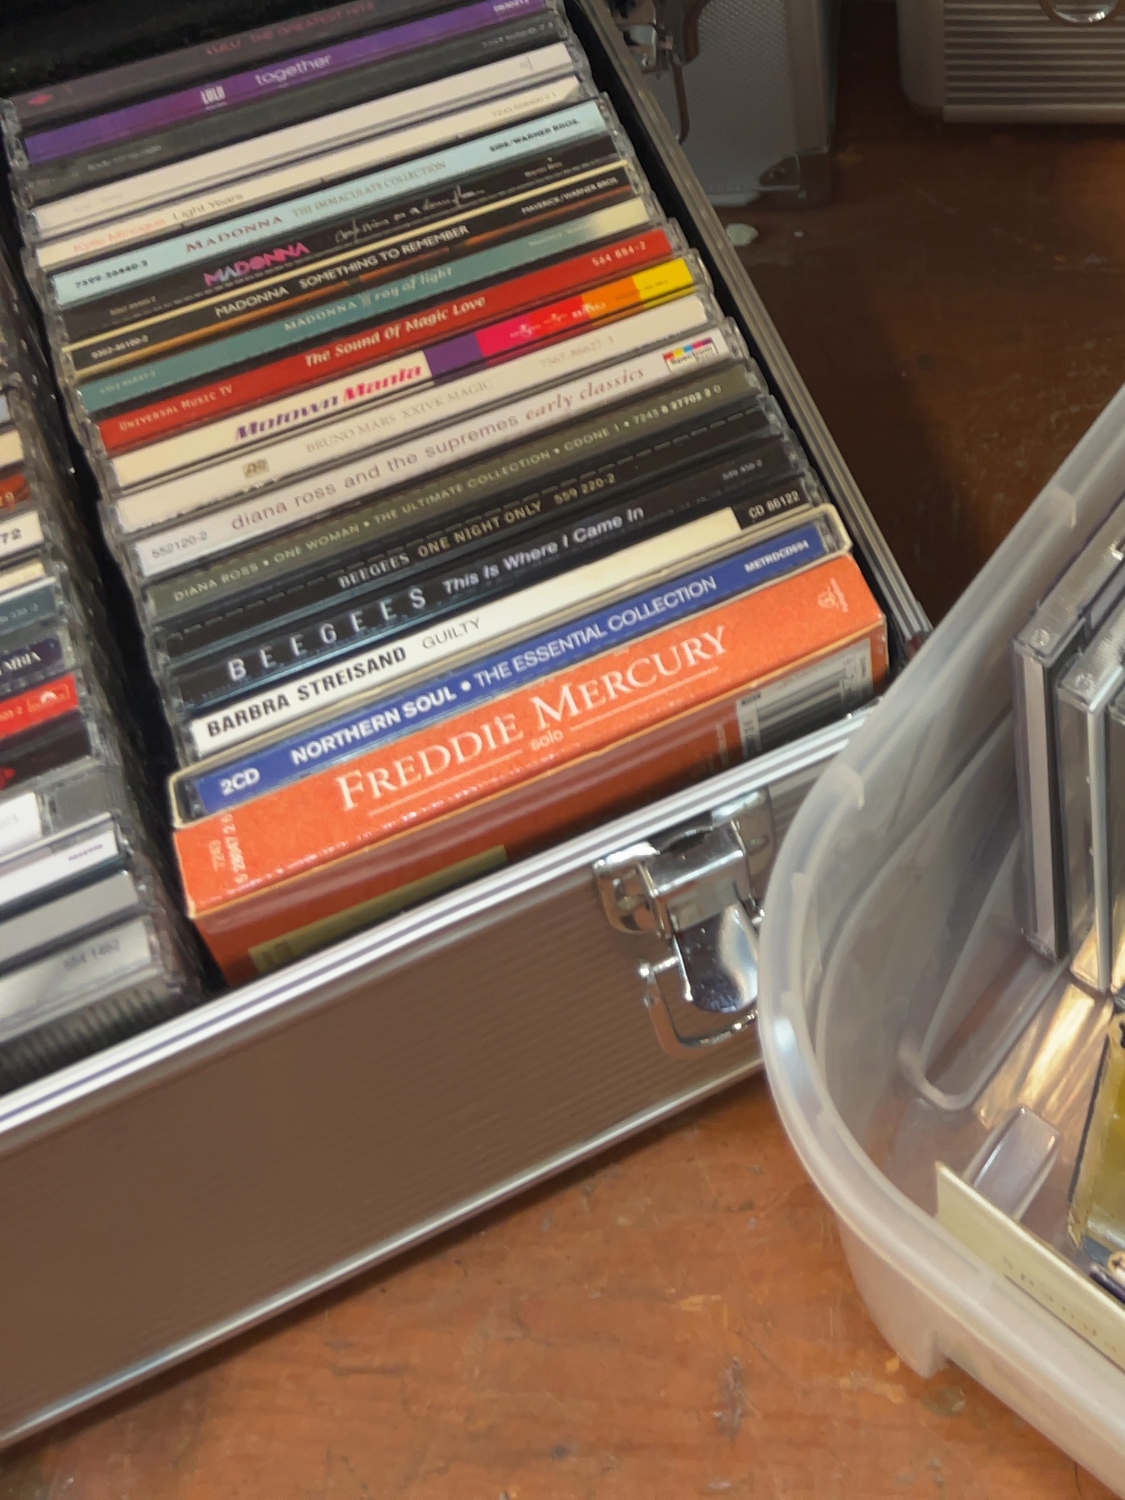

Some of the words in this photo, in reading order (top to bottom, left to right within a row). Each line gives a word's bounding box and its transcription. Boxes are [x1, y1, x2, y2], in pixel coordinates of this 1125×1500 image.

[253, 52, 333, 89] together
[382, 158, 448, 189] COLLECTION
[172, 203, 205, 222] Light
[184, 211, 282, 253] MADONNA
[202, 238, 311, 287] MADONNA
[213, 283, 290, 319] MADONNA
[298, 253, 378, 289] SOMETHING
[378, 246, 401, 264] TO
[400, 223, 470, 255] REMEMBER
[283, 300, 357, 332] MADONNA
[372, 284, 401, 304] ray
[418, 264, 454, 287] light
[303, 348, 331, 367] The
[332, 330, 382, 357] Sound
[382, 323, 403, 339] Of
[403, 306, 453, 335] Magic
[450, 294, 488, 316] Love
[217, 381, 235, 397] TV
[231, 391, 340, 442] Motown
[340, 362, 424, 403] Mania
[305, 426, 356, 454] BRUNO
[355, 411, 397, 436] MARS
[445, 377, 494, 404] MAGIC
[229, 497, 288, 532] diana
[292, 481, 337, 508] ross
[341, 462, 381, 490] and
[385, 448, 419, 473] the
[423, 412, 521, 462] supremes
[521, 388, 576, 425] early
[575, 361, 647, 402] classics
[172, 576, 218, 603] DIANA
[219, 560, 259, 585] ROSS
[272, 543, 303, 565] ONE
[304, 522, 361, 551] WOMAN
[372, 507, 398, 525] THE
[400, 482, 464, 515] ULTIMATE
[465, 449, 552, 490] COLLECTION
[337, 550, 411, 589] BEEGEES
[416, 534, 451, 559] ONE
[451, 514, 503, 544] NIGHT
[502, 498, 544, 524] ONLY
[440, 568, 481, 596] This
[480, 560, 501, 580] Is
[501, 537, 559, 572] Where
[559, 532, 570, 548] I
[569, 511, 625, 545] Came
[624, 503, 645, 522] In
[746, 503, 766, 521] CD
[204, 692, 291, 738] BARBRA
[293, 644, 408, 702] STREISAND
[419, 615, 483, 651] GUILTY
[289, 706, 402, 765] NORTHERN
[399, 682, 458, 720] SOUL
[471, 659, 513, 689] THE
[511, 620, 609, 672] ESSENTIAL
[605, 575, 720, 634] COLLECTION
[333, 703, 525, 811] FREDDIE
[528, 620, 734, 731] MERCURY
[217, 765, 262, 796] 2CD
